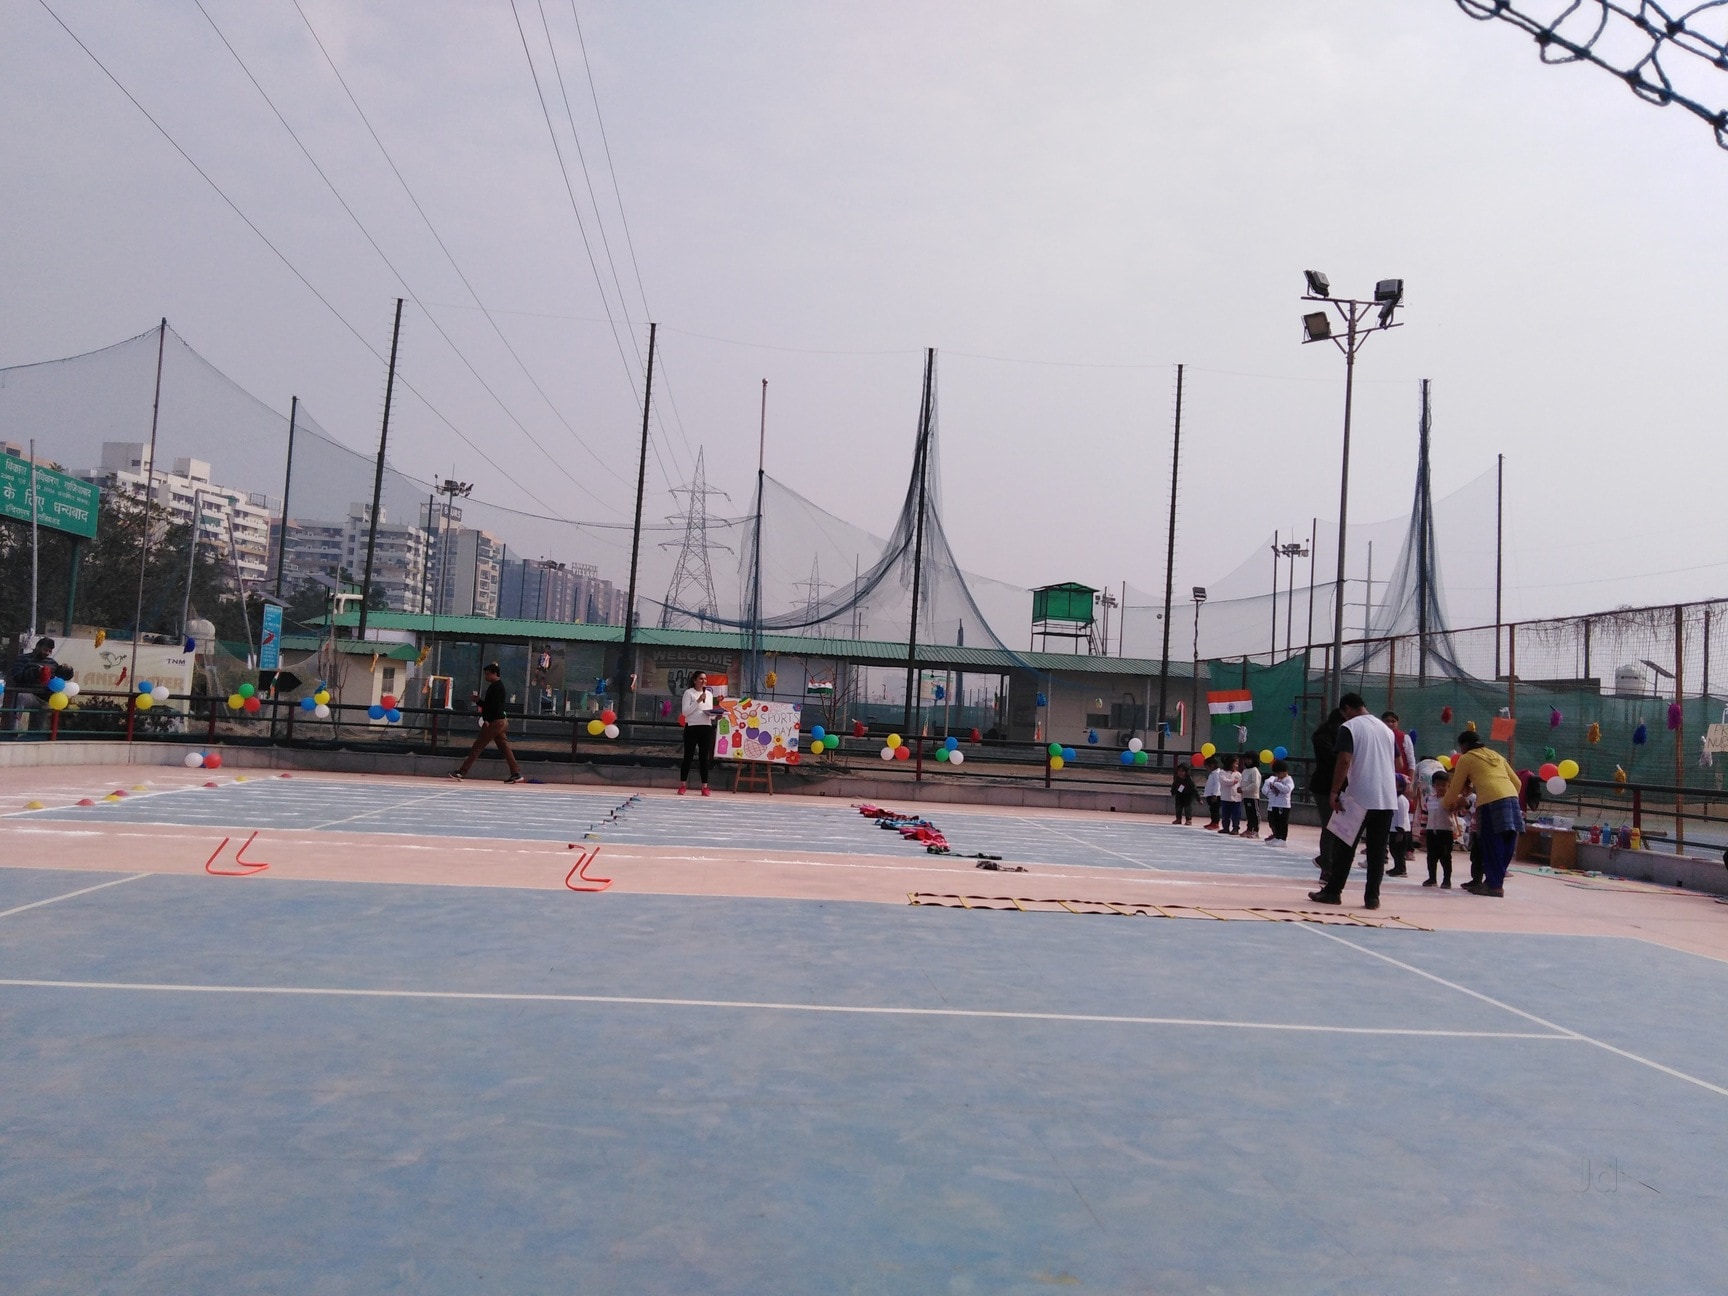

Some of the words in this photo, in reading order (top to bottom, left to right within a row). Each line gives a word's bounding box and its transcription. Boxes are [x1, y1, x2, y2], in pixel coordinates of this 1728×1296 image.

[3, 482, 16, 500] के
[652, 650, 733, 666] WELCOME
[760, 712, 800, 724] SPORTS
[773, 726, 792, 737] DAY
